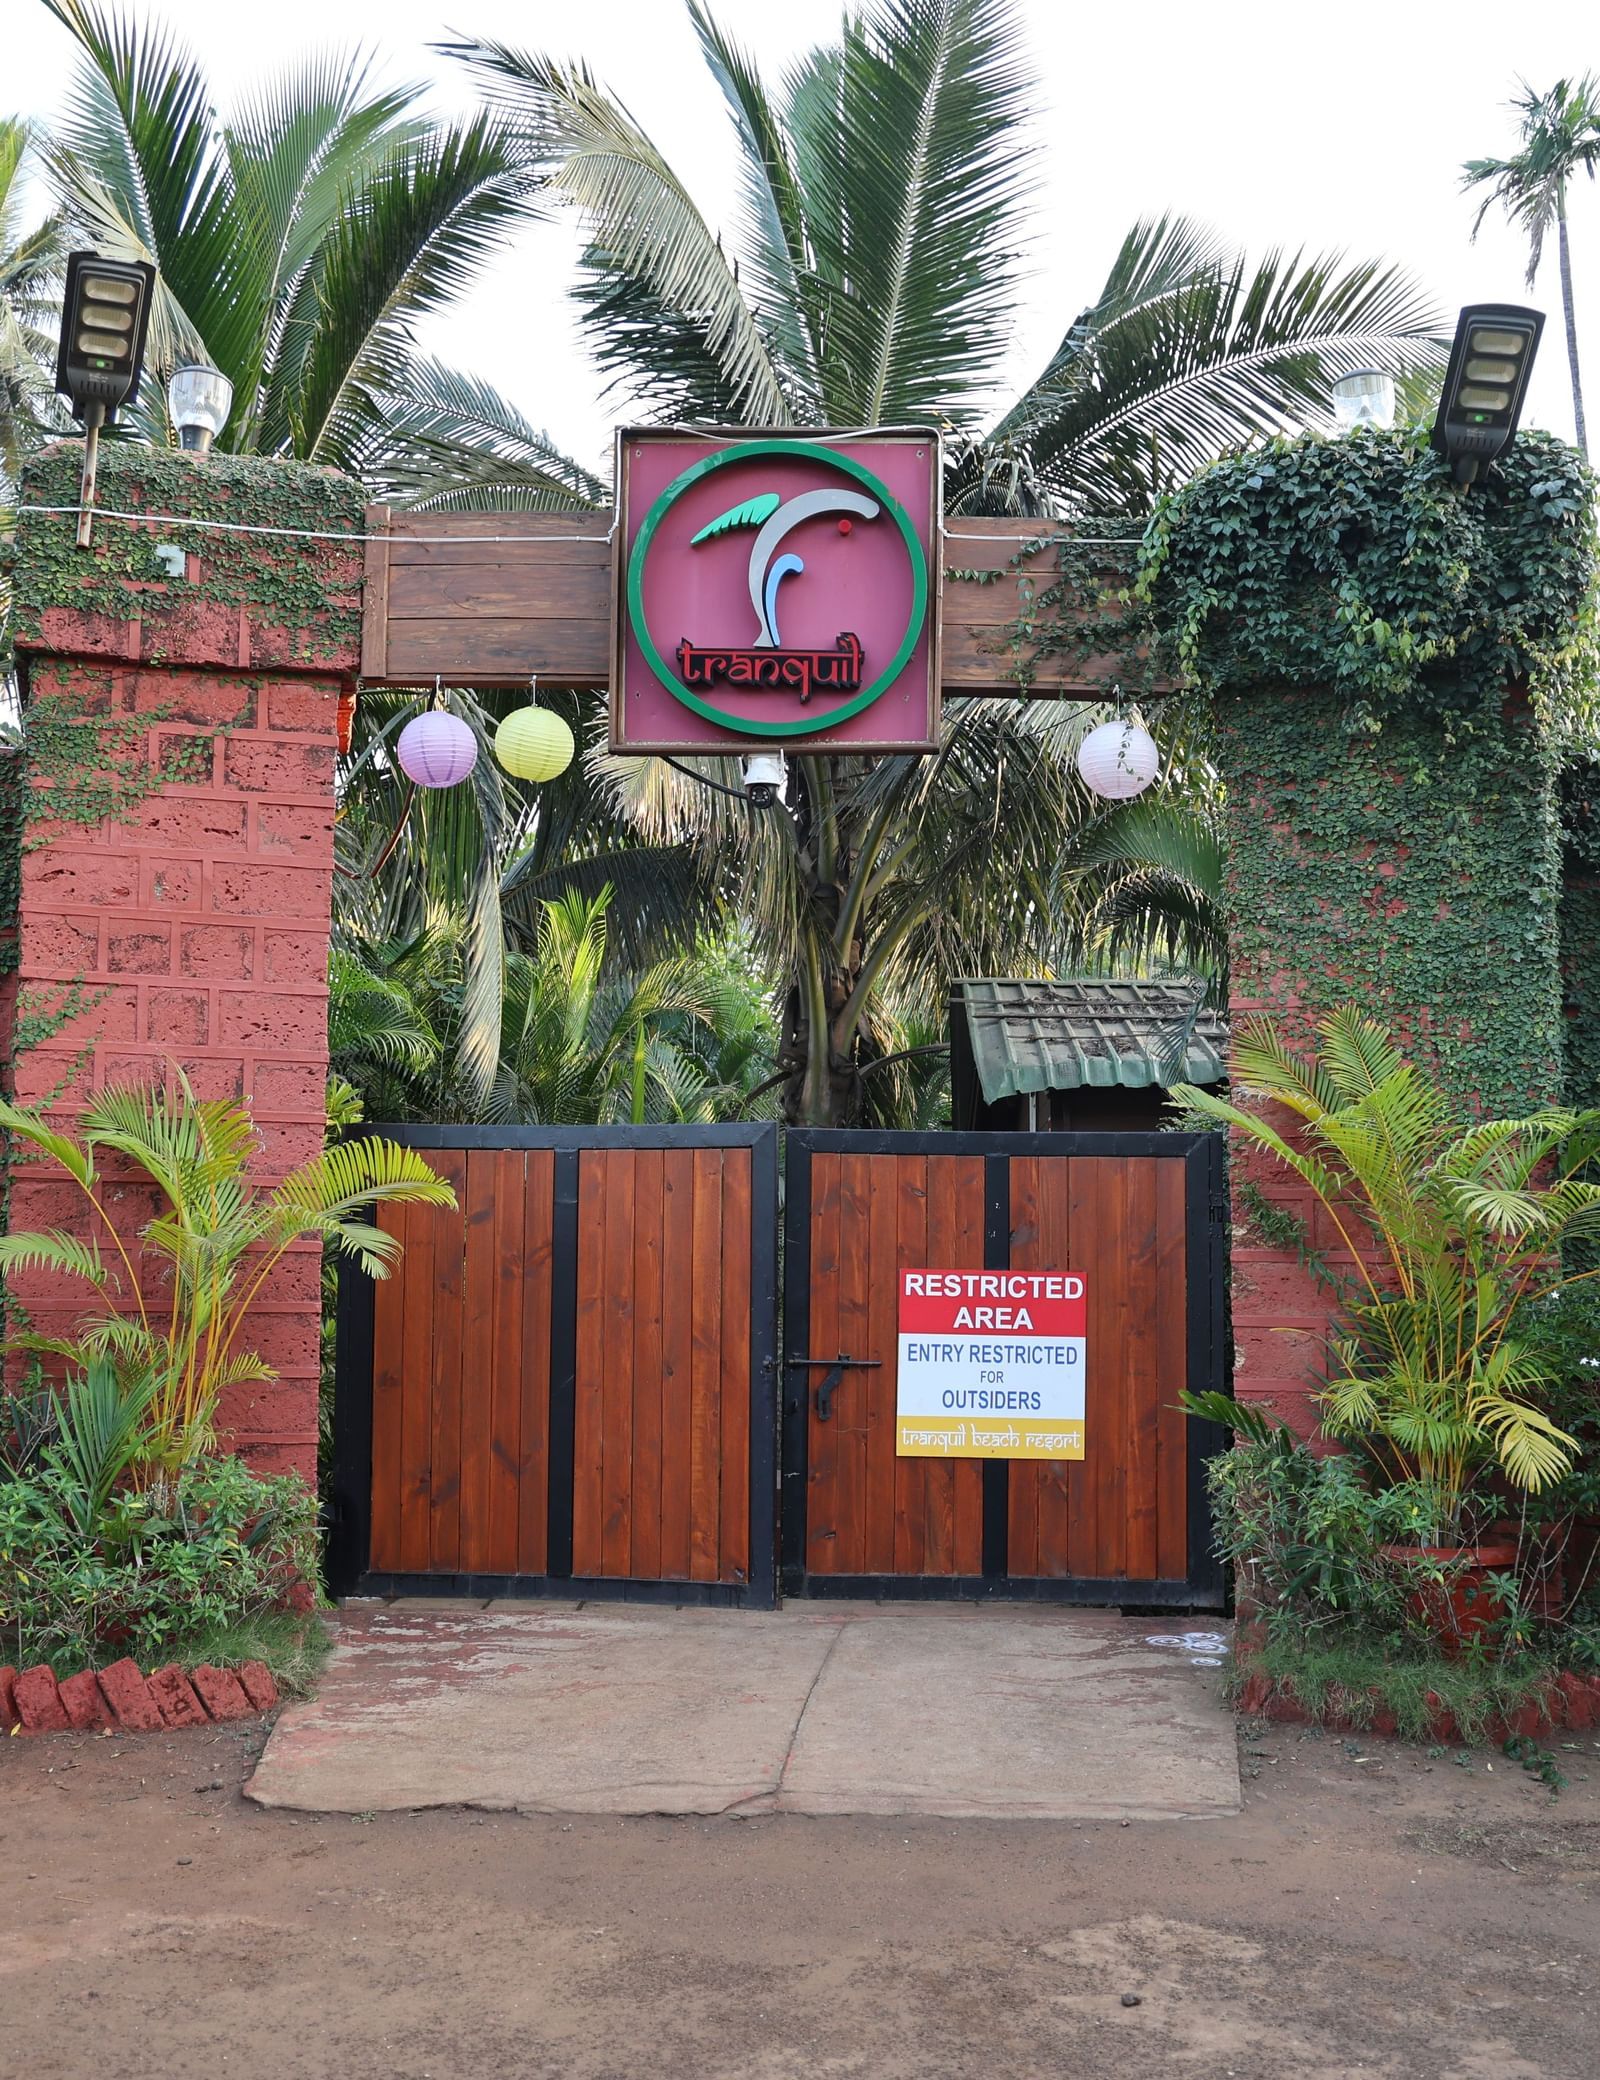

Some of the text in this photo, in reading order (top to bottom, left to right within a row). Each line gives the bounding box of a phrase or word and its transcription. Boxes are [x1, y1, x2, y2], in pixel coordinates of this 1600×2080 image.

[676, 632, 865, 704] tranquil
[905, 1274, 1084, 1299] RESTRICTED
[953, 1307, 1034, 1330] AREA
[907, 1343, 1078, 1365] ENTRY RESTRICTED
[980, 1371, 1004, 1383] FOR
[942, 1390, 1041, 1410] OUTSIDERS
[901, 1423, 1081, 1453] tranquil beach resort
